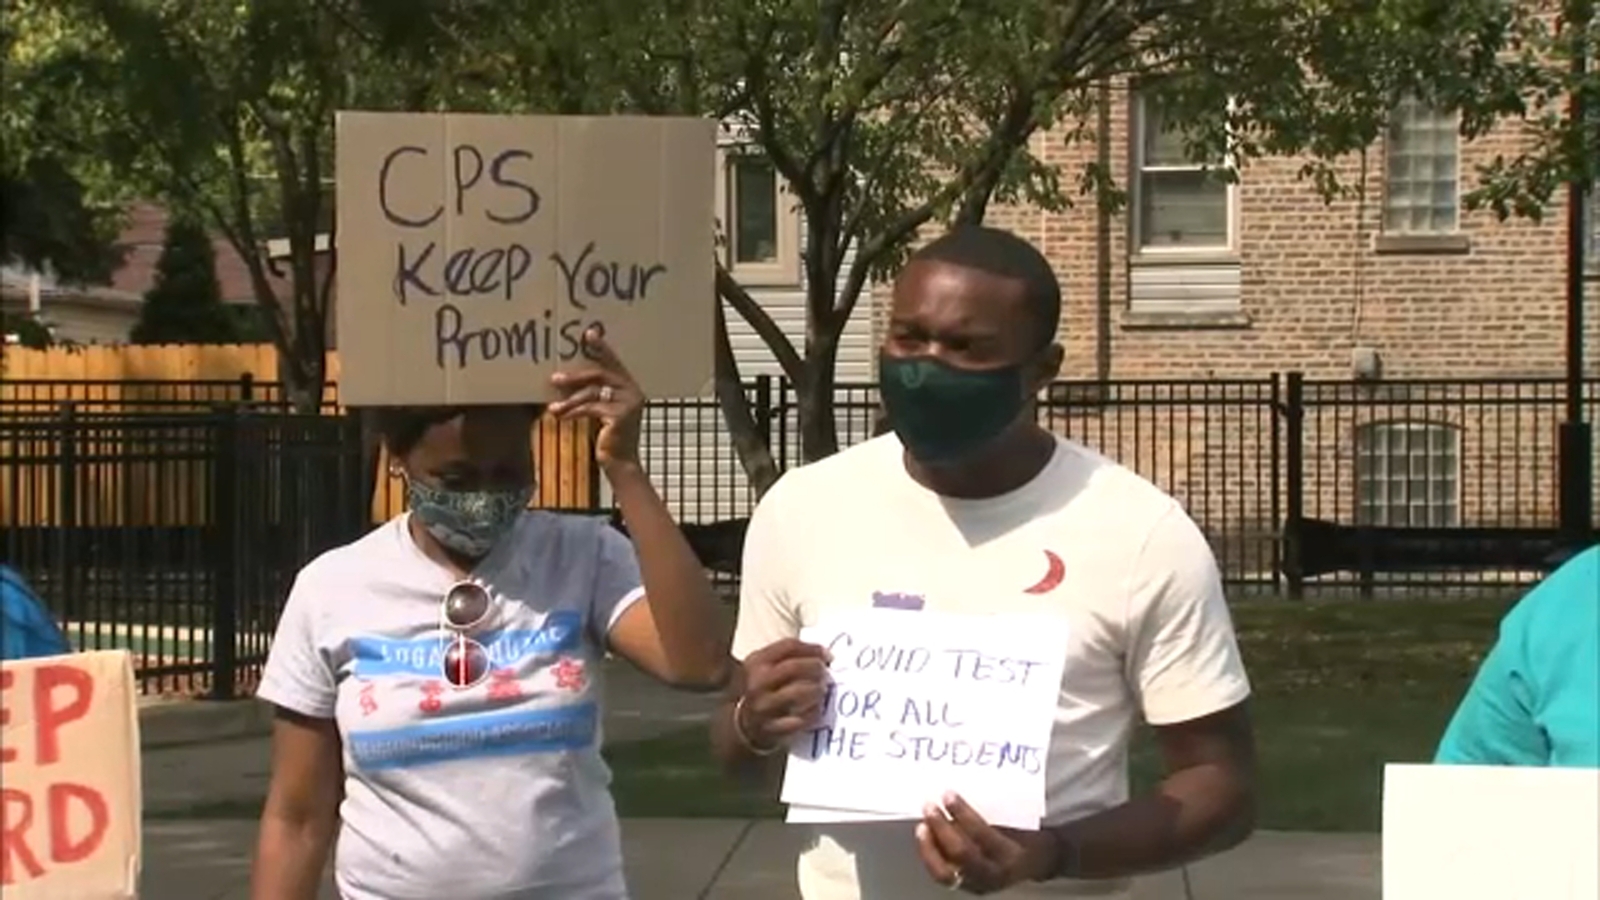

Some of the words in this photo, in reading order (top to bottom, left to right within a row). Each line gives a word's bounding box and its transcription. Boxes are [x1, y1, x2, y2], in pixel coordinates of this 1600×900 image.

[378, 144, 541, 228] CPS
[549, 240, 667, 311] Your
[435, 303, 606, 369] Promise
[379, 643, 444, 670] LOGA
[826, 631, 931, 674] COVID
[942, 648, 1050, 686] TEST
[822, 681, 882, 721] FOR
[900, 696, 965, 727] ALL
[805, 724, 870, 761] THE
[886, 730, 1044, 775] STUDENTS
